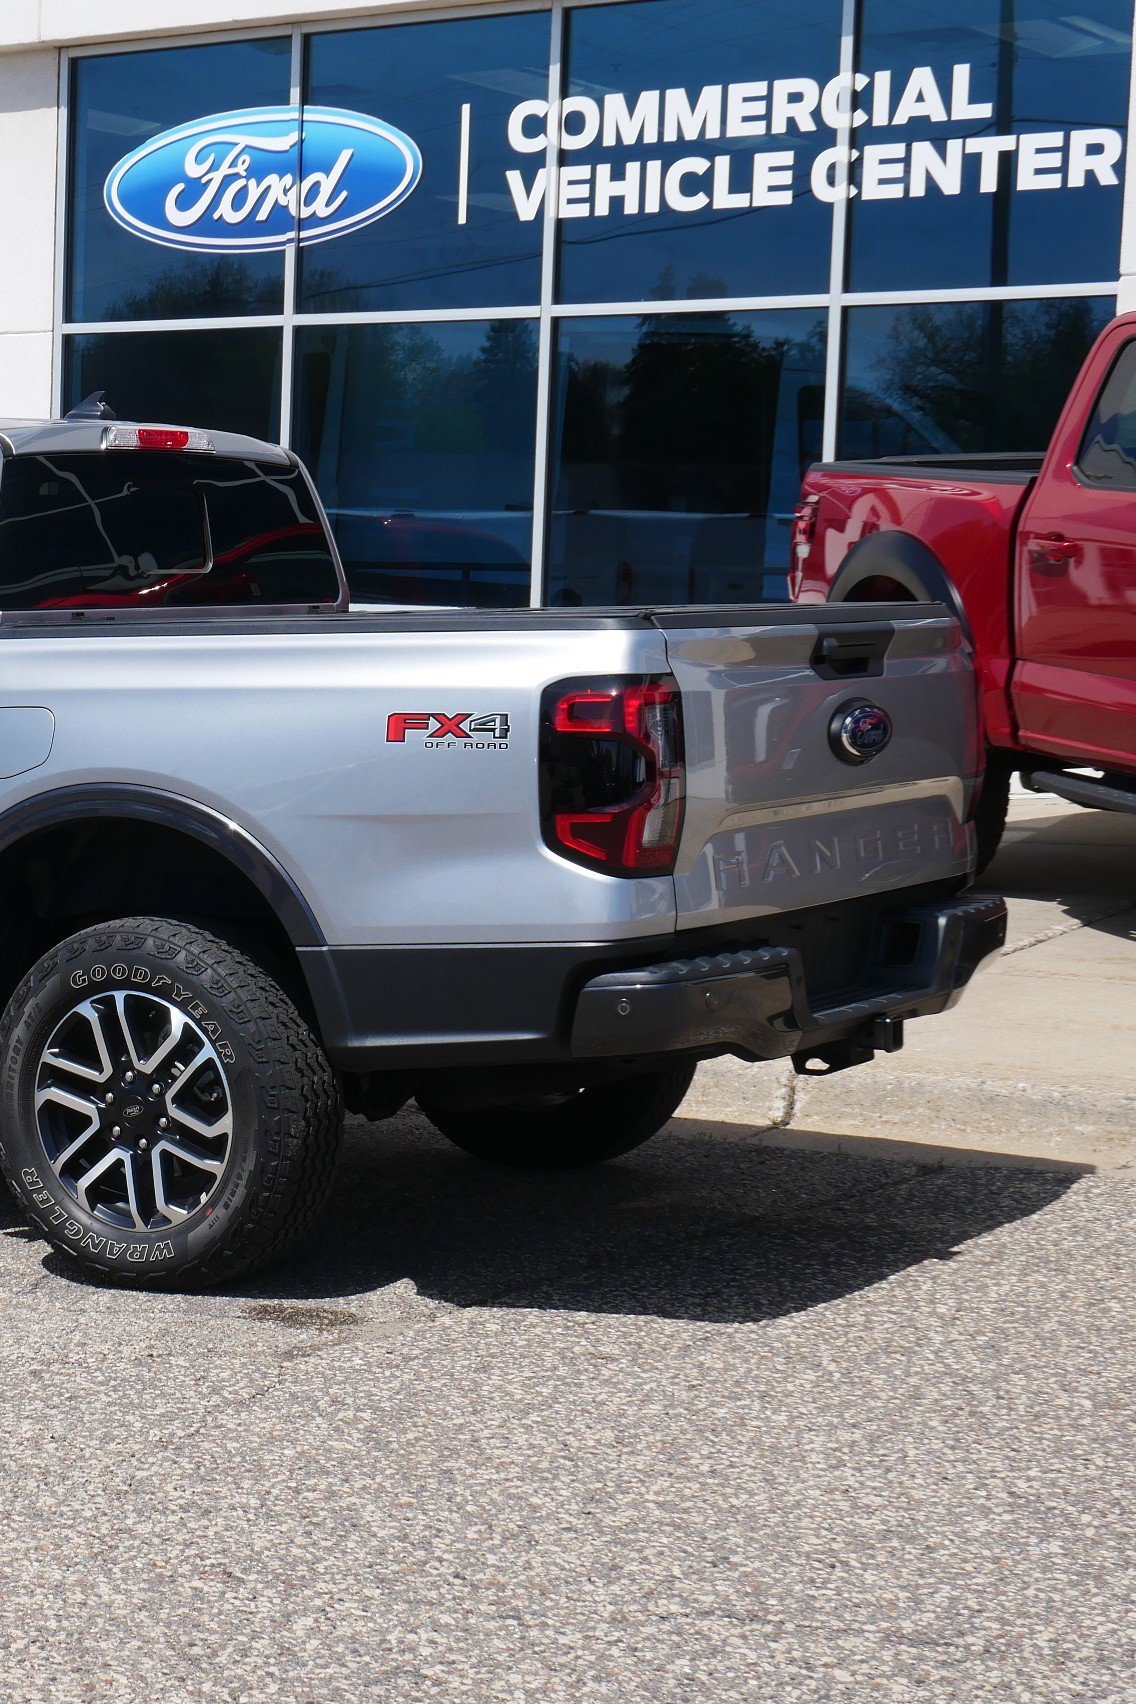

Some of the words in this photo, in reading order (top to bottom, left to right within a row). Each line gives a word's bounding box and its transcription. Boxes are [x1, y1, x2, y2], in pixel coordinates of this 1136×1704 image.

[507, 63, 993, 154] COMMERCIAL
[165, 131, 354, 228] Ford
[506, 150, 795, 222] VEHICLE
[810, 128, 1123, 203] CENTER
[386, 712, 510, 742] FX4
[424, 741, 457, 749] OFF
[463, 742, 509, 750] ROAD
[70, 963, 236, 1064] GOODYEAR
[22, 1167, 176, 1263] WRANGLER
